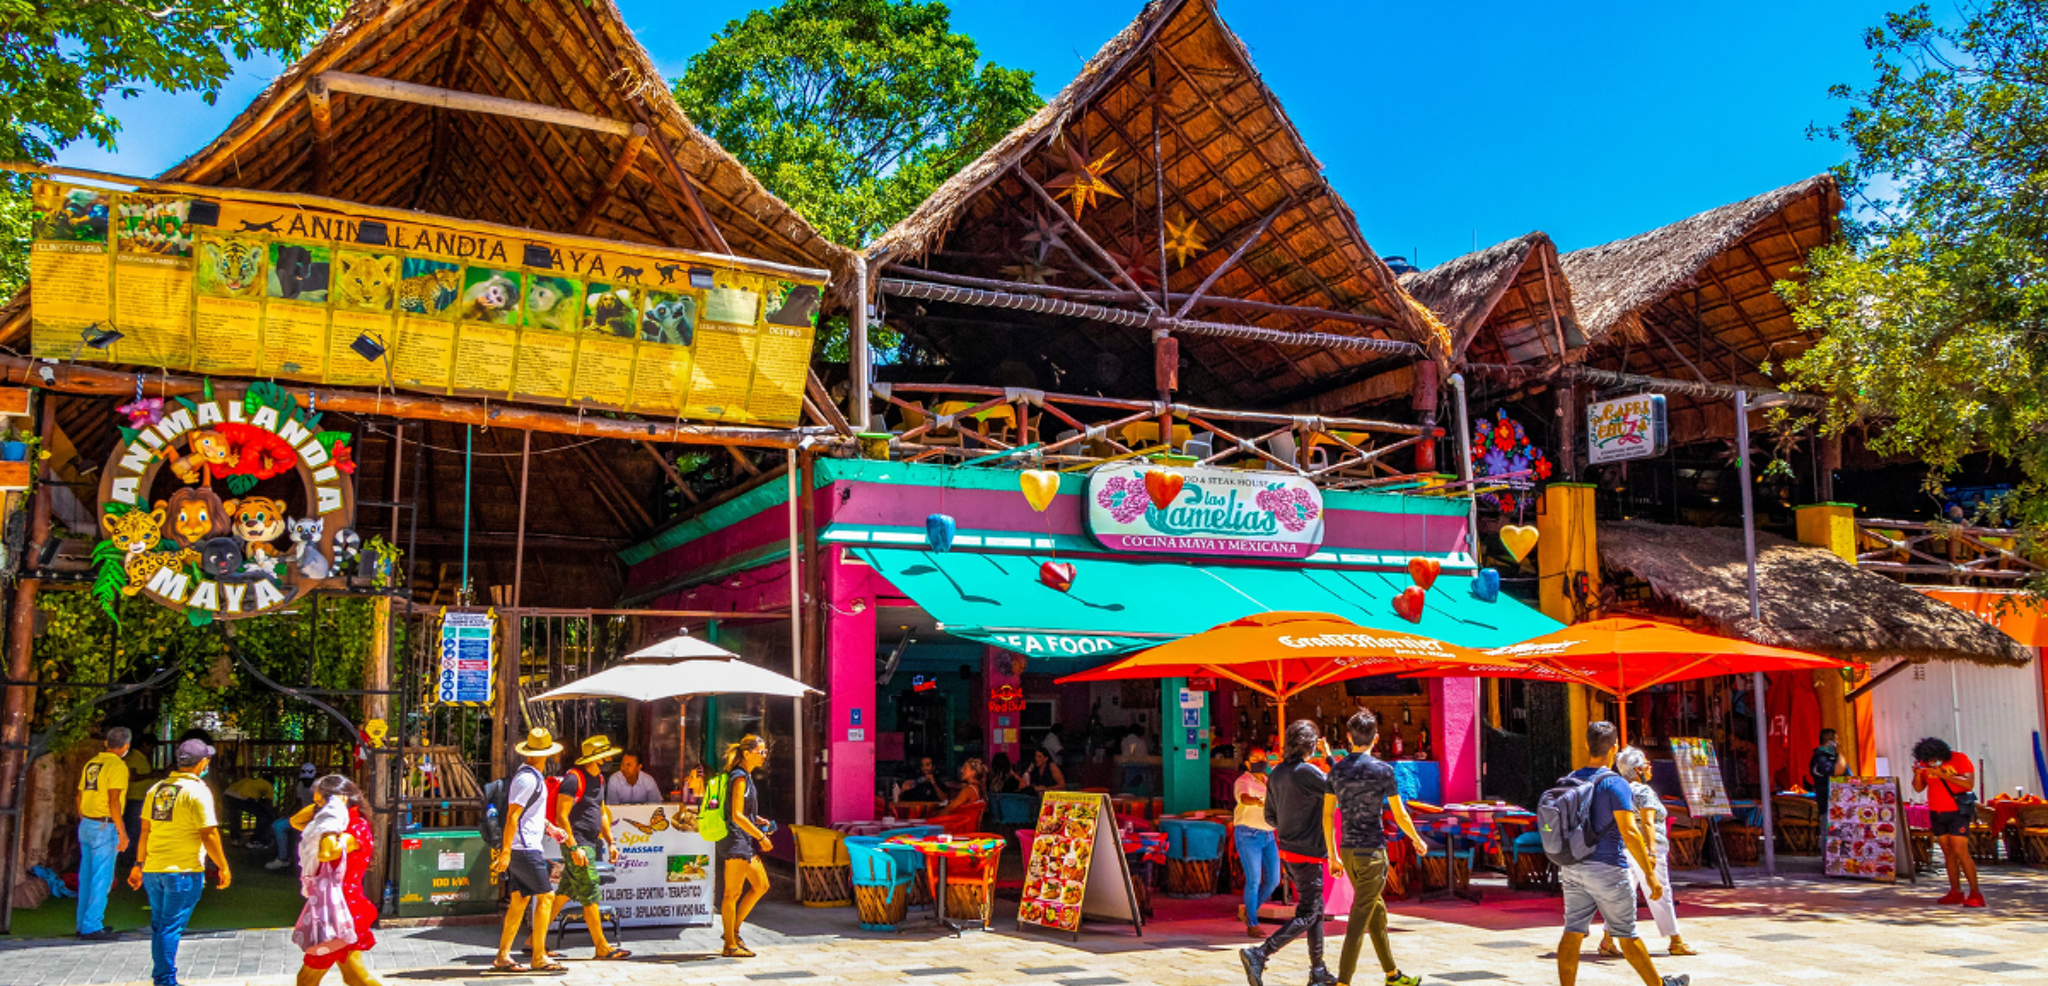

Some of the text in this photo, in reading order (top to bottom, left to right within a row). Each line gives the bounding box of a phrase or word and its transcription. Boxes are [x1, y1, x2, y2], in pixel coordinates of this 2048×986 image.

[523, 247, 607, 278] AYA
[112, 400, 342, 515] ANIMALANDIA
[1204, 490, 1227, 507] las
[1122, 535, 1298, 554] COCINA MAYA Y MEXICANA
[146, 565, 286, 614] MAYA
[1046, 636, 1114, 655] FOOD
[989, 700, 1027, 713] Red Bull
[619, 831, 651, 847] Spa
[432, 877, 450, 888] 100
